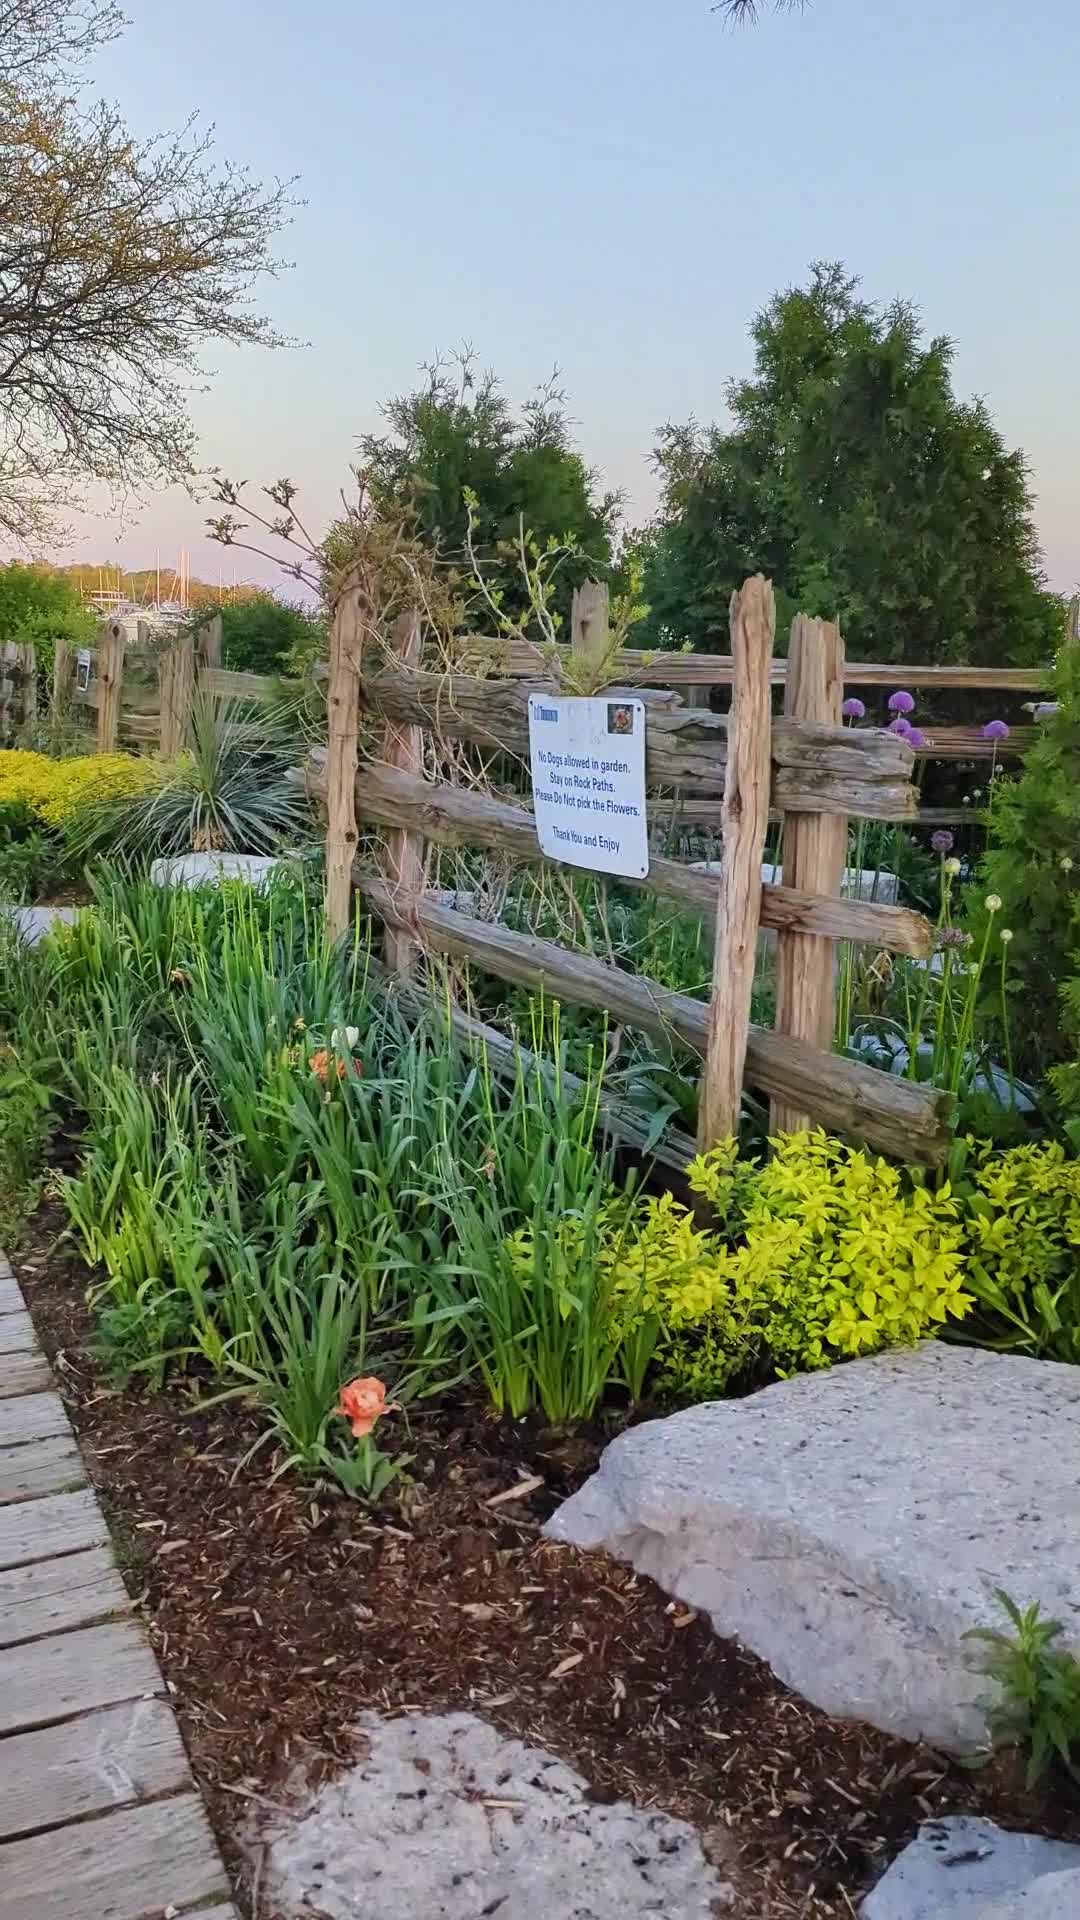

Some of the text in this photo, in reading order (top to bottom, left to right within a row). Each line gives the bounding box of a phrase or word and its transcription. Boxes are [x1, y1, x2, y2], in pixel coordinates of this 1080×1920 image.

[538, 751, 630, 774] No Dogs allowed in garden.
[550, 772, 616, 793] Stay on Rock Paths.
[536, 789, 640, 816] Please Do Not pick the Flowers.
[552, 826, 620, 854] Thank You and Enjoy
